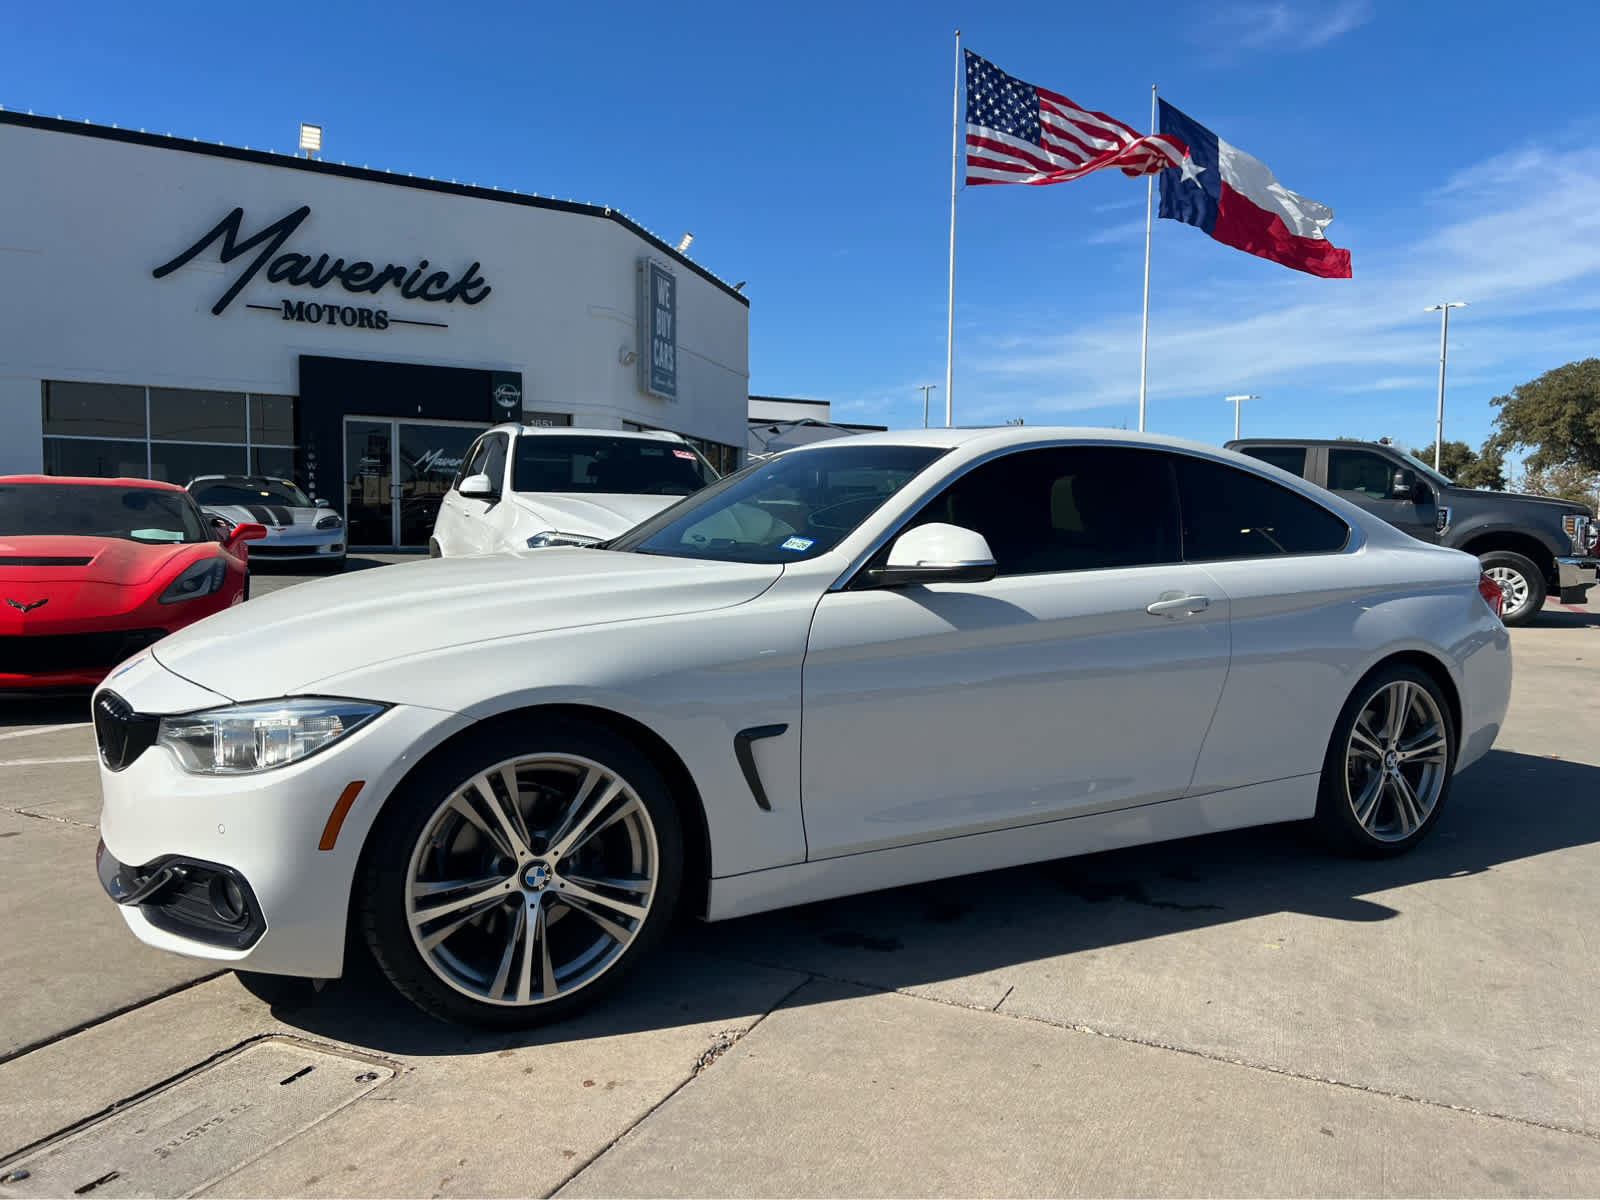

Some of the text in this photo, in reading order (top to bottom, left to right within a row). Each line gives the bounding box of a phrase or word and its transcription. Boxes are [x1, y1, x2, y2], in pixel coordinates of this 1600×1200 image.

[152, 205, 492, 315] Maverick
[656, 275, 671, 309] WE
[281, 299, 390, 330] MOTORS
[655, 307, 672, 340] BUY
[653, 338, 674, 372] CARS
